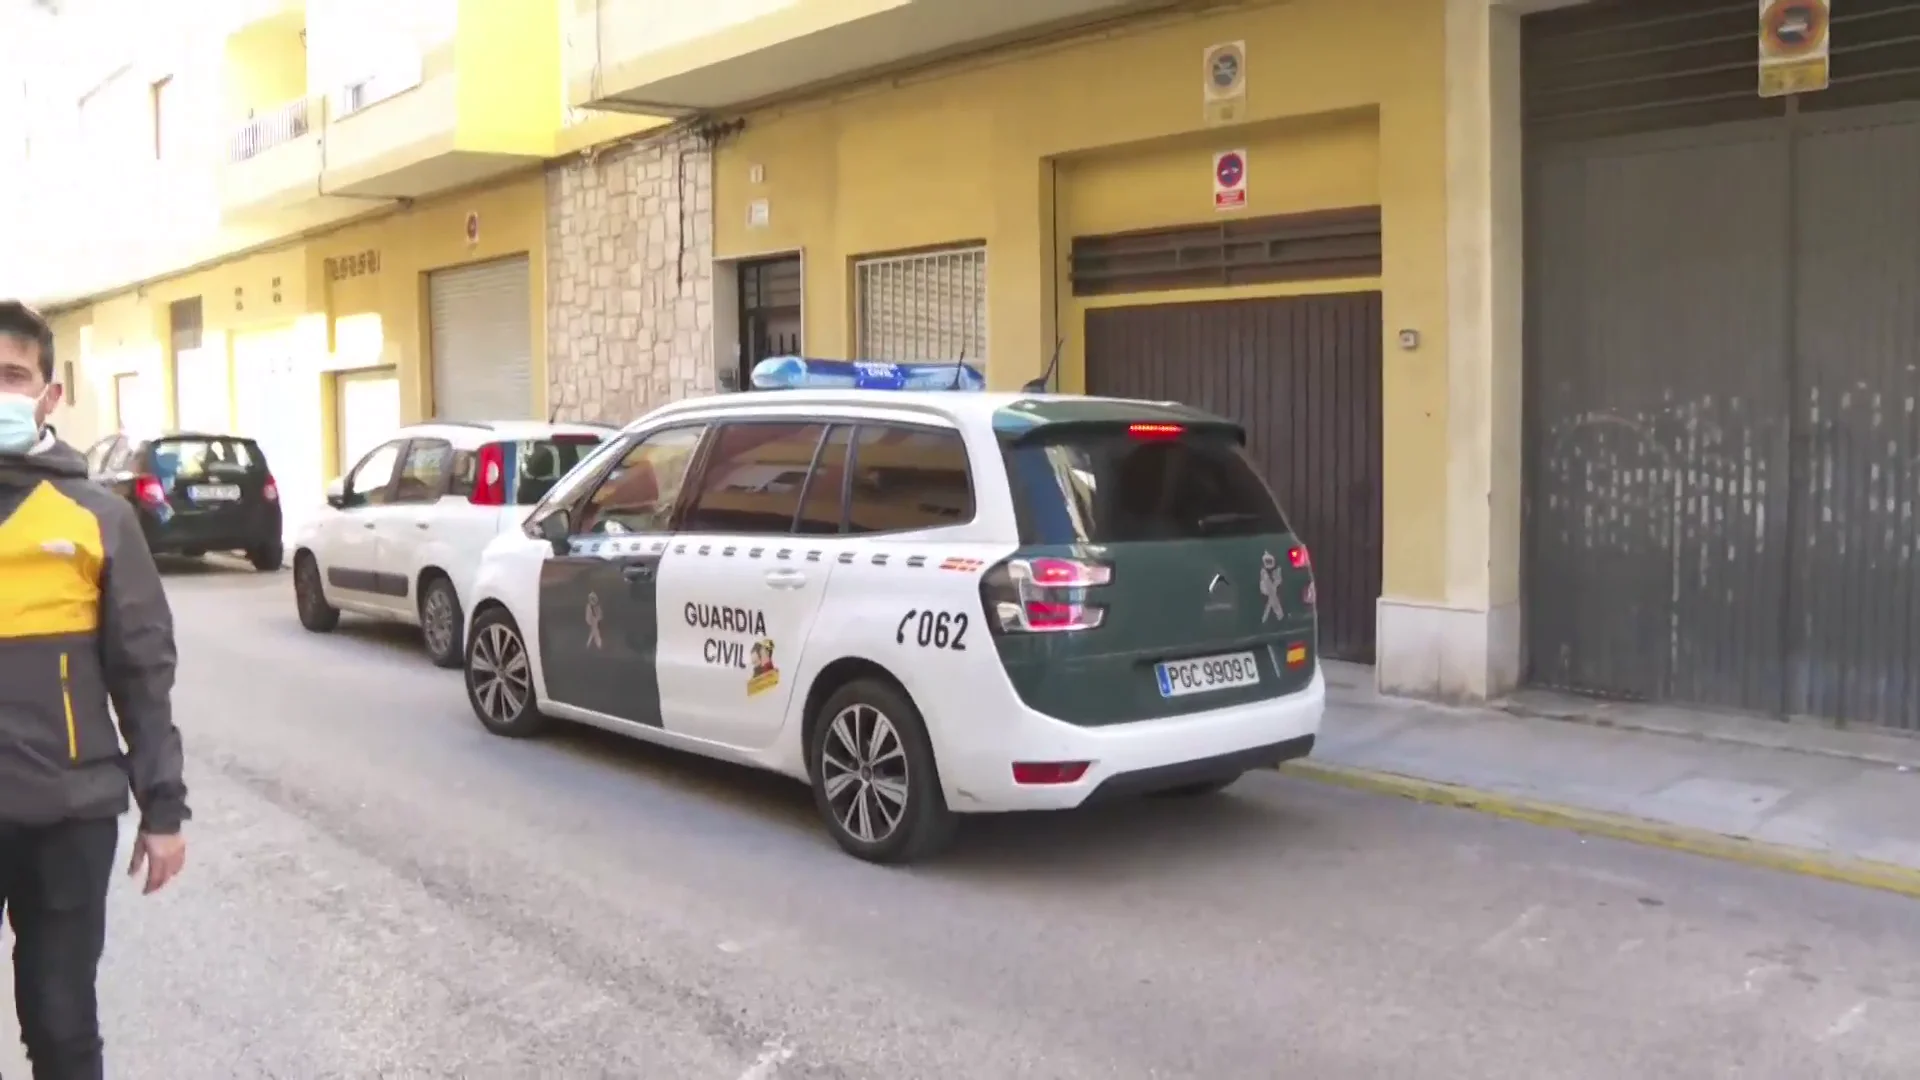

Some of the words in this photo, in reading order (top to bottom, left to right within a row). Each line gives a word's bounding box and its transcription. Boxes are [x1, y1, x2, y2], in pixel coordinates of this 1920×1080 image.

[684, 602, 767, 636] GUARDIA
[917, 609, 969, 650] 062
[703, 638, 747, 669] CIVIL
[1168, 664, 1202, 689] PGC
[1203, 658, 1243, 685] 9909
[1244, 657, 1256, 679] C
